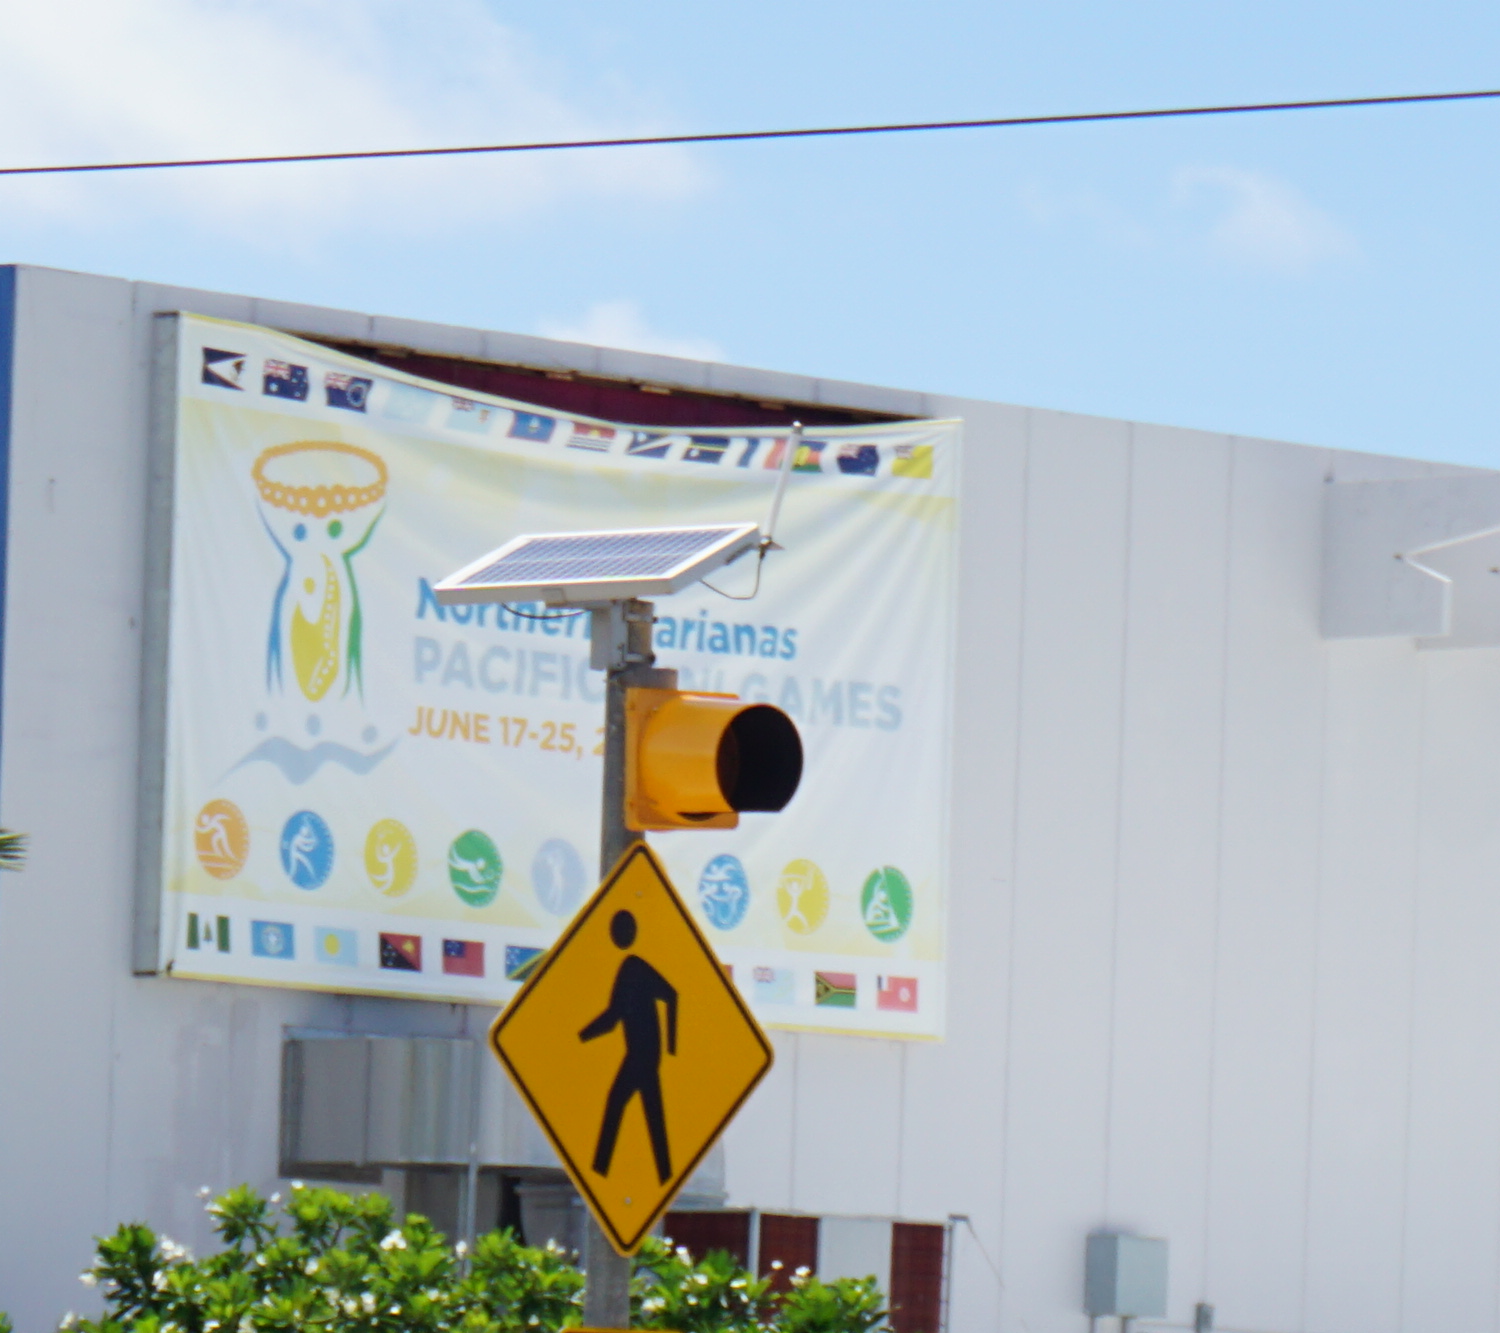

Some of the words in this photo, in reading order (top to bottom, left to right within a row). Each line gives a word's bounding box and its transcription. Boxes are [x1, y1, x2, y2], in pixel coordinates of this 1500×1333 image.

[654, 608, 797, 661] arianas
[413, 636, 607, 705] PACIFIC
[739, 672, 903, 733] GAMES
[408, 705, 491, 745] JUNE
[498, 716, 584, 761] 17-25,
